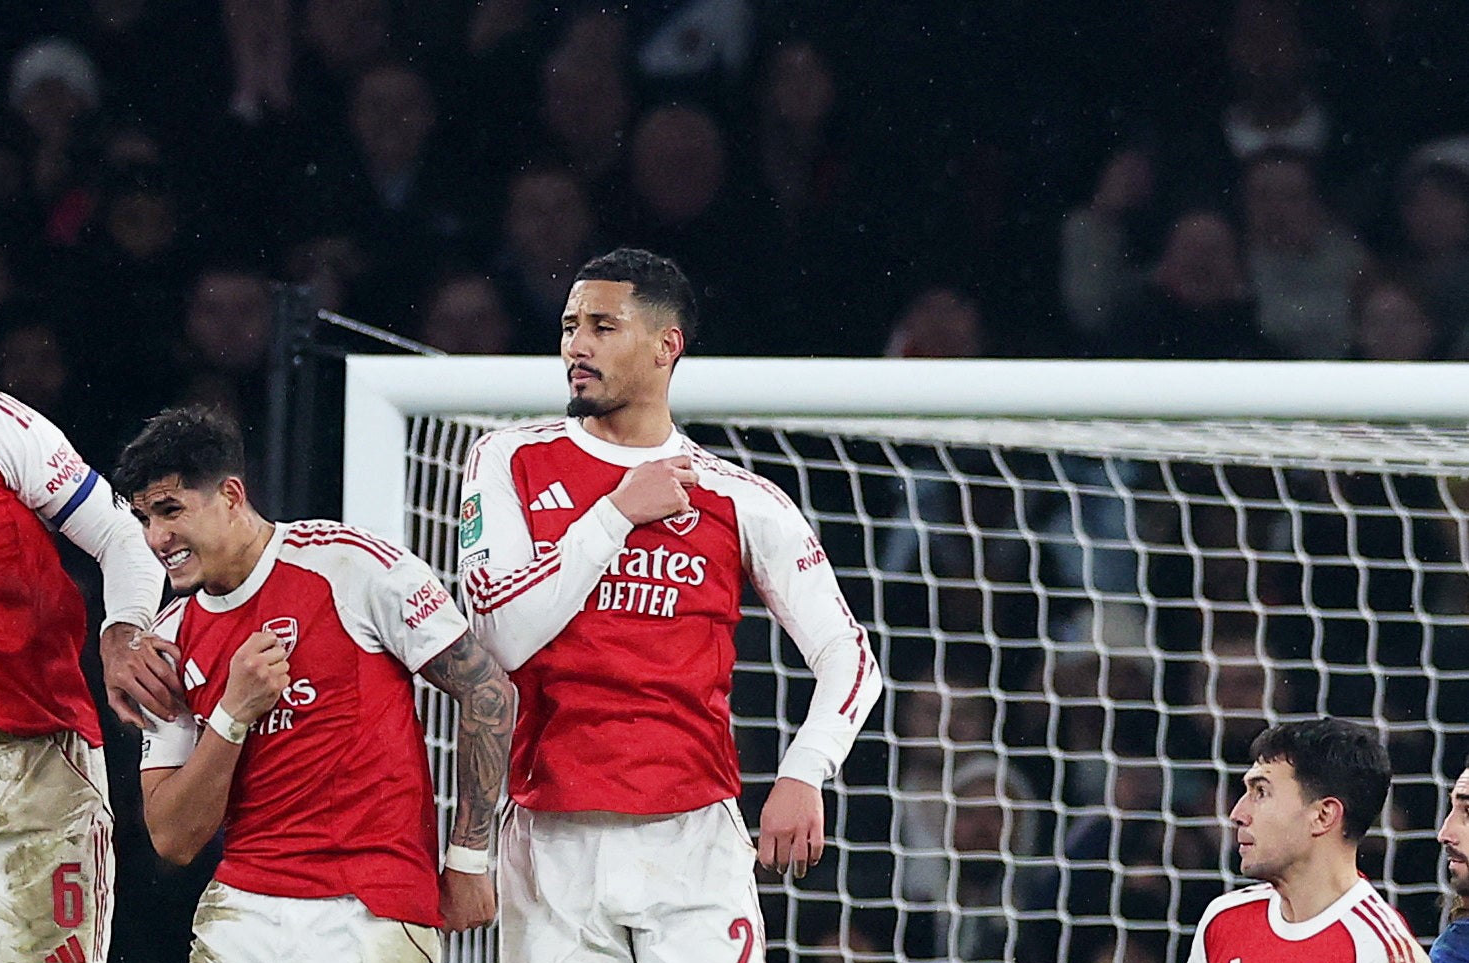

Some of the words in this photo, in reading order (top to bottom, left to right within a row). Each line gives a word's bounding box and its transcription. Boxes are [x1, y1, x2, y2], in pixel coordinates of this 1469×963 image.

[603, 544, 707, 586] rates
[596, 581, 679, 618] BETTER
[52, 862, 85, 928] 6
